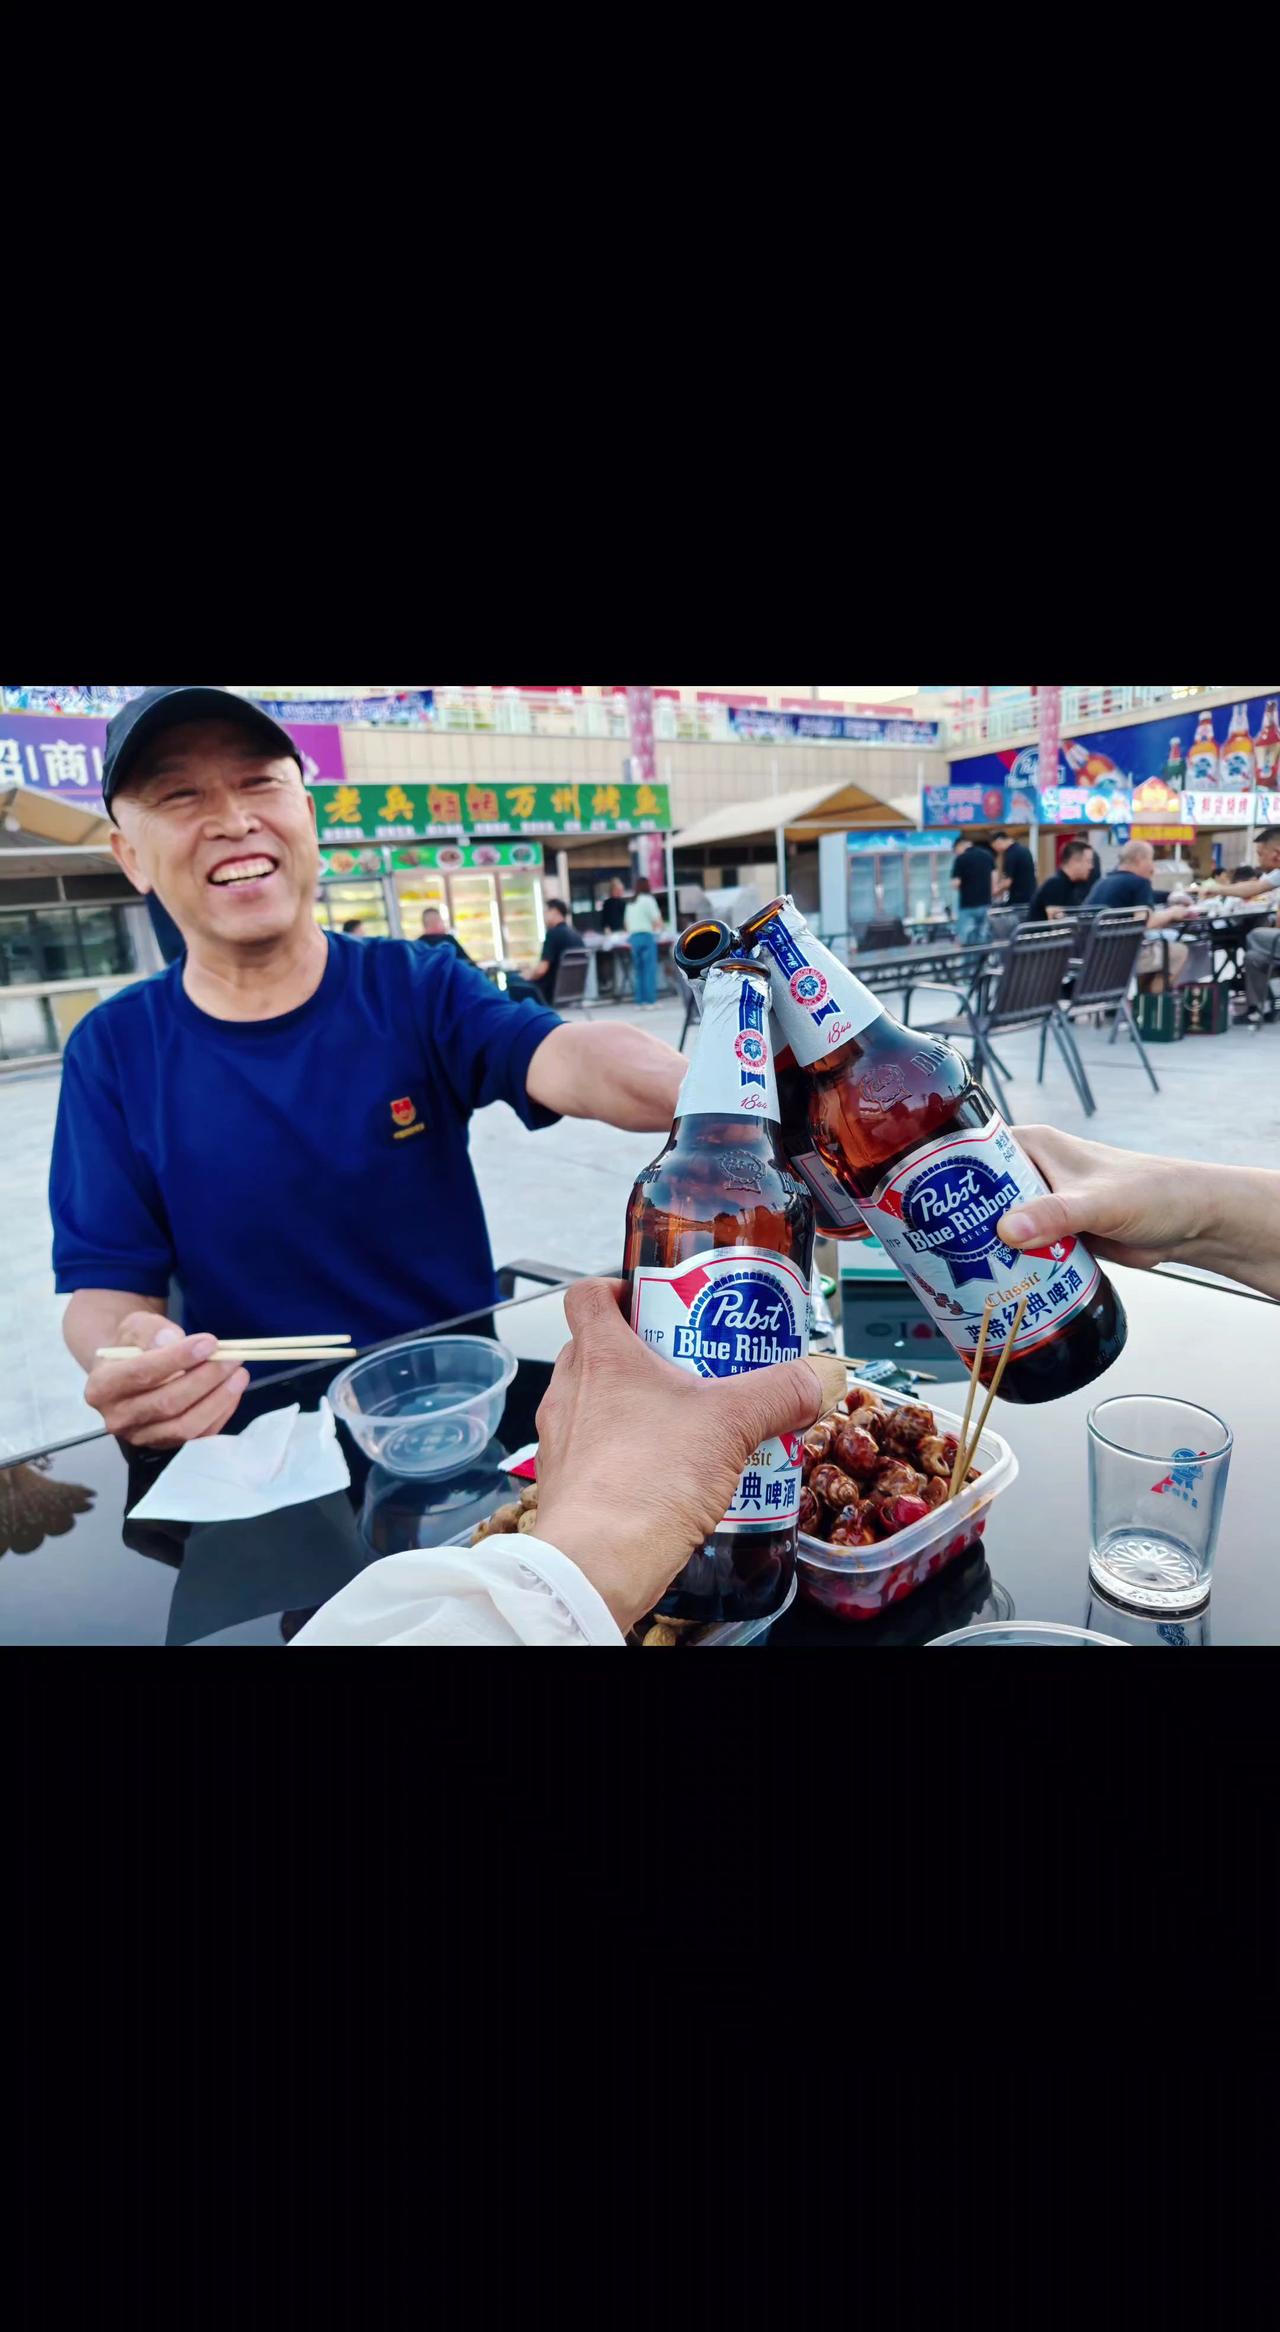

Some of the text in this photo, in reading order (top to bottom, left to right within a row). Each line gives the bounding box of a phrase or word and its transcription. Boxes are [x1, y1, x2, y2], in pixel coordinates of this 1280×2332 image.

[911, 1169, 980, 1223] Pabst
[906, 1183, 1018, 1252] Blue Ribbon
[961, 1225, 989, 1244] BEER
[984, 1272, 1041, 1307] Classic
[711, 1289, 783, 1331] Pabst
[677, 1328, 799, 1364] Blue Ribbon
[727, 1471, 796, 1511] 典啤酒
